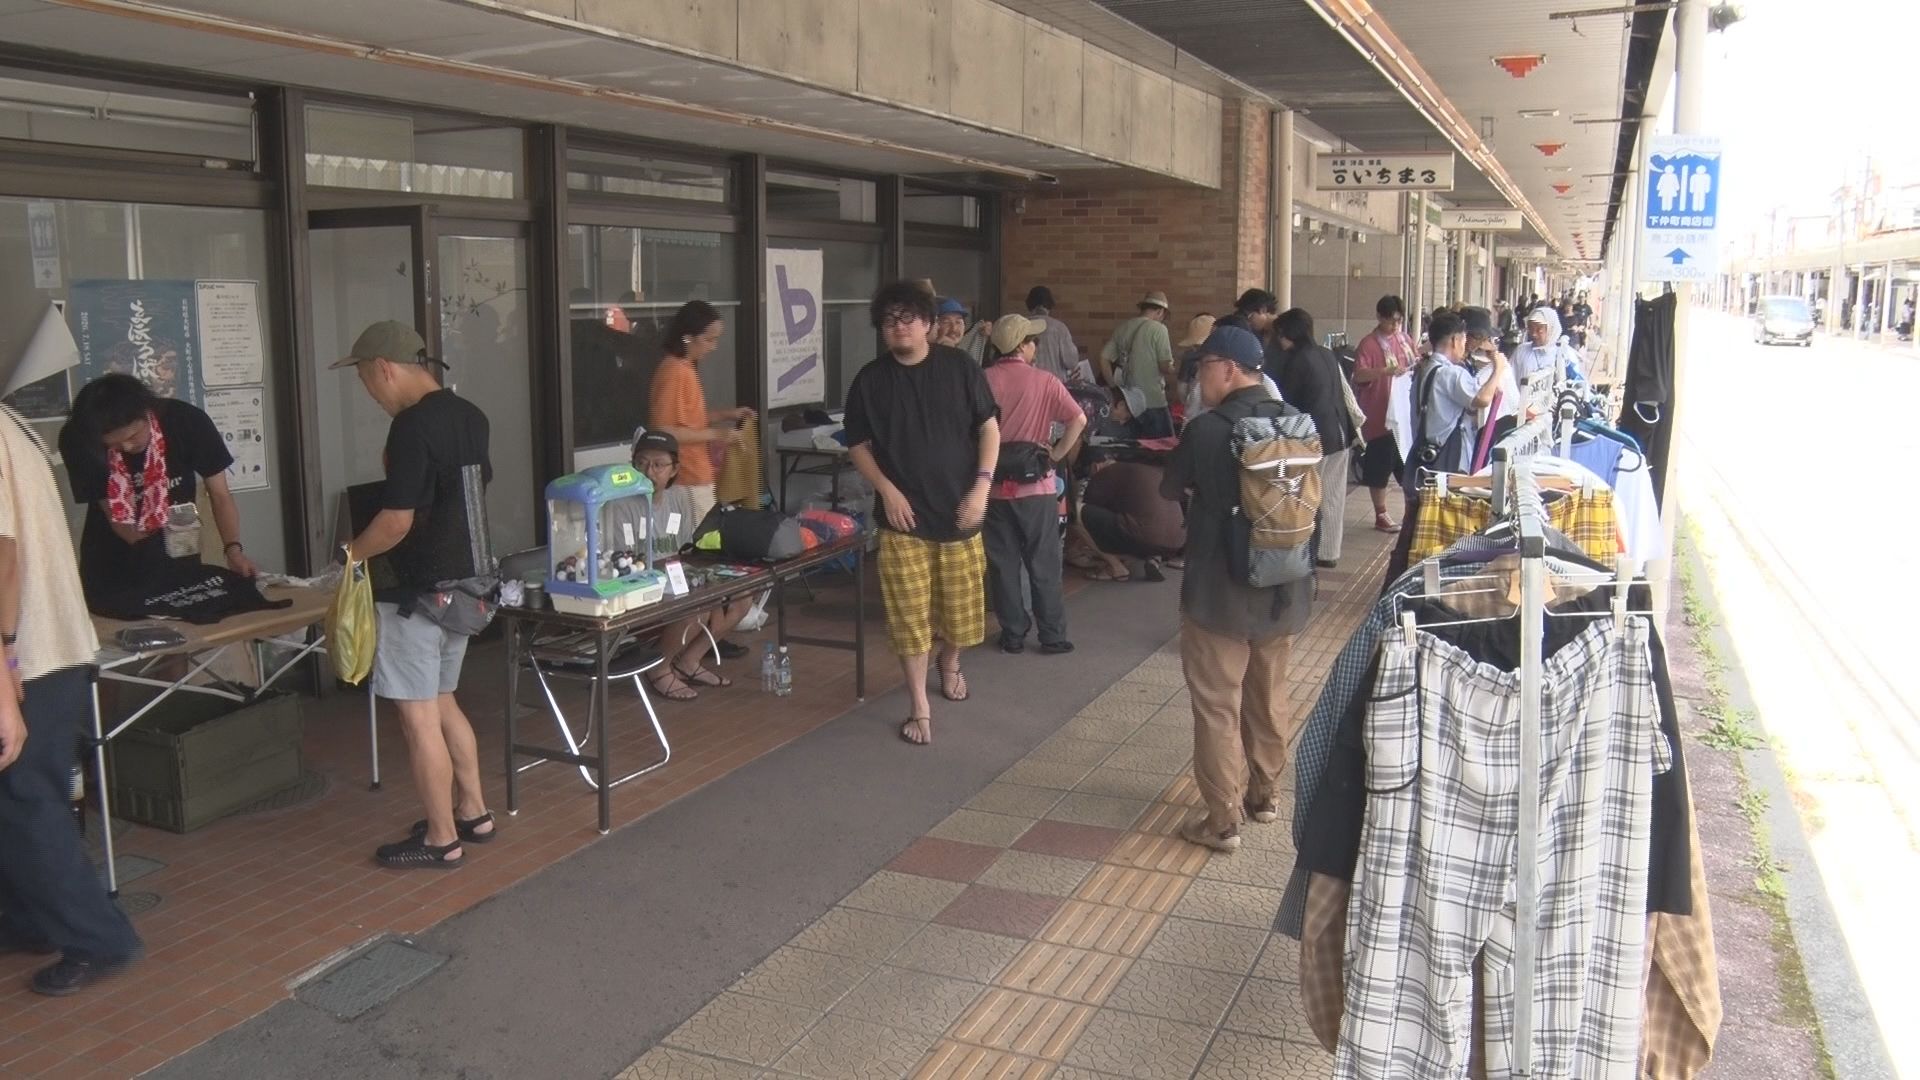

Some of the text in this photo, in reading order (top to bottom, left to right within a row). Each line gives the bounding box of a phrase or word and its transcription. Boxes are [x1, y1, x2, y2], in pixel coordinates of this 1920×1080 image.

[1649, 216, 1713, 226] 下仲町商店街
